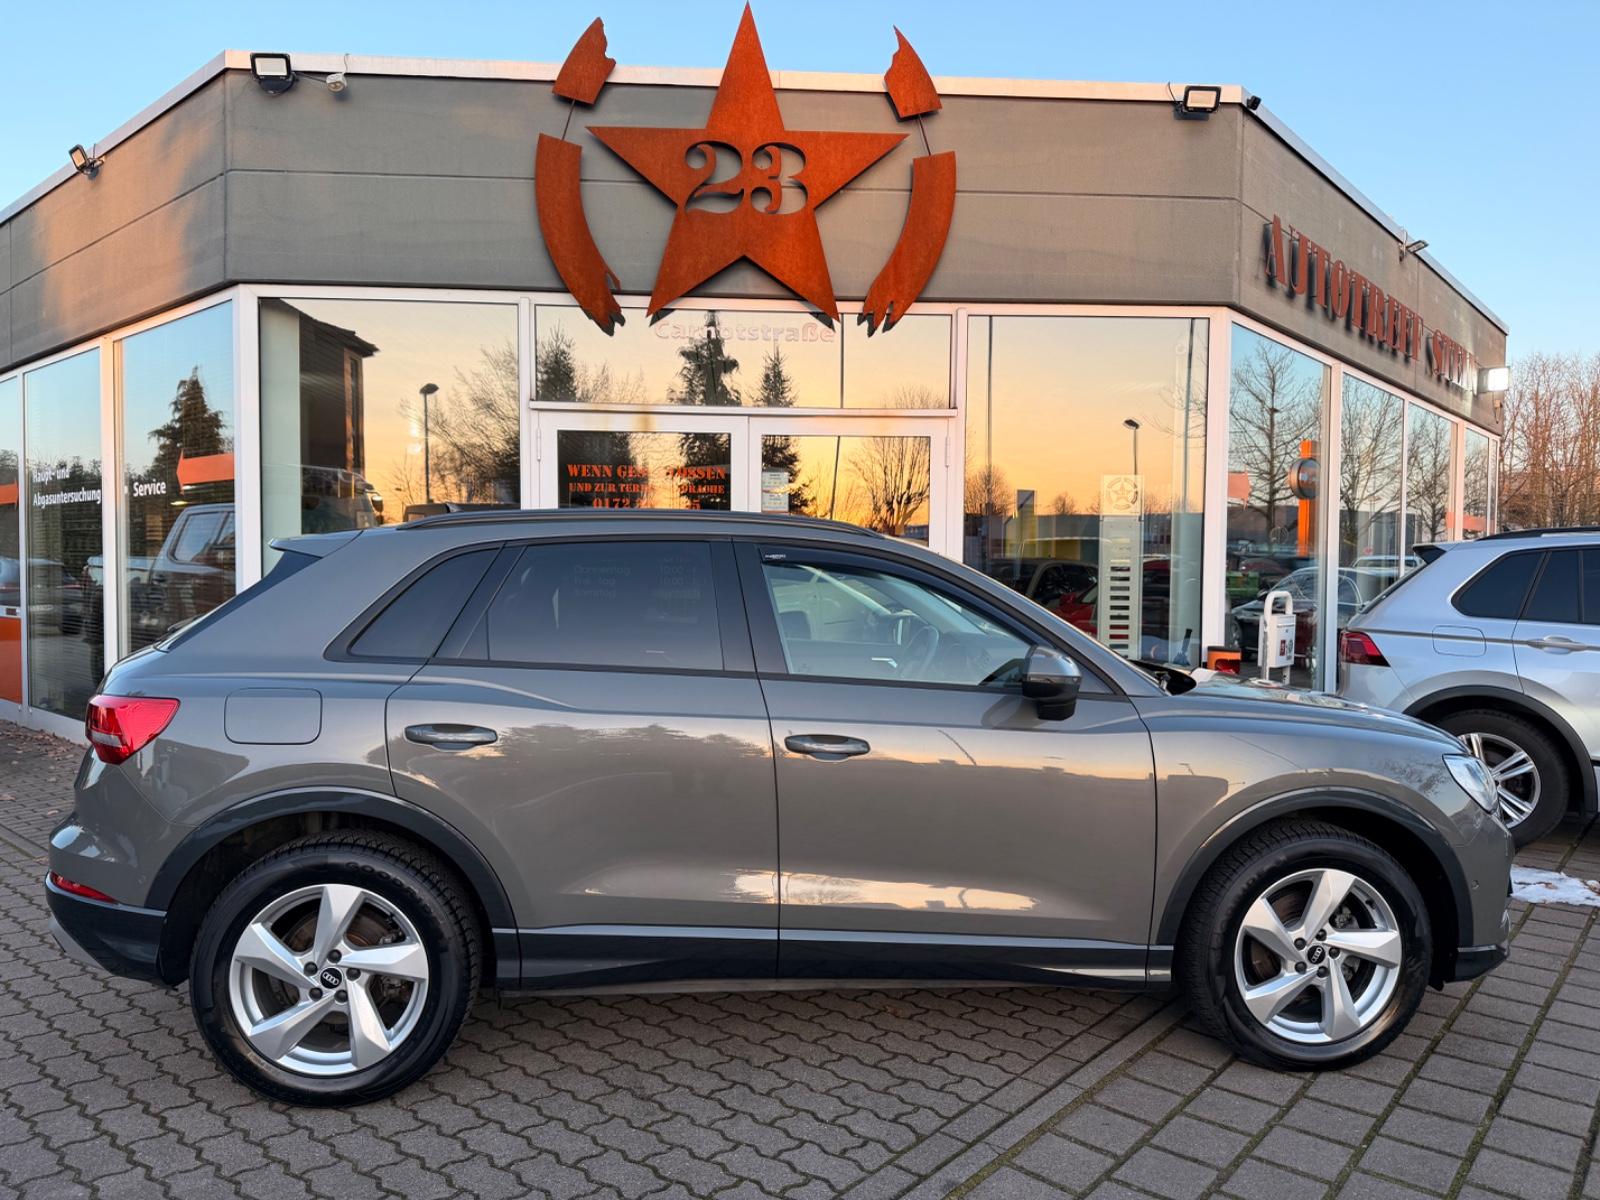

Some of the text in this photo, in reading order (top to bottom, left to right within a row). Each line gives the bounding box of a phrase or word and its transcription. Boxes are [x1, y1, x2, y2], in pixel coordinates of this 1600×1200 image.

[685, 141, 808, 214] 23
[1265, 214, 1424, 362] AUTOTREFF
[57, 466, 70, 479] und
[567, 464, 613, 478] WENN
[133, 479, 167, 497] Service
[569, 483, 592, 493] UND
[595, 483, 616, 493] ZUR
[33, 486, 101, 509] Abgasuntersuchung
